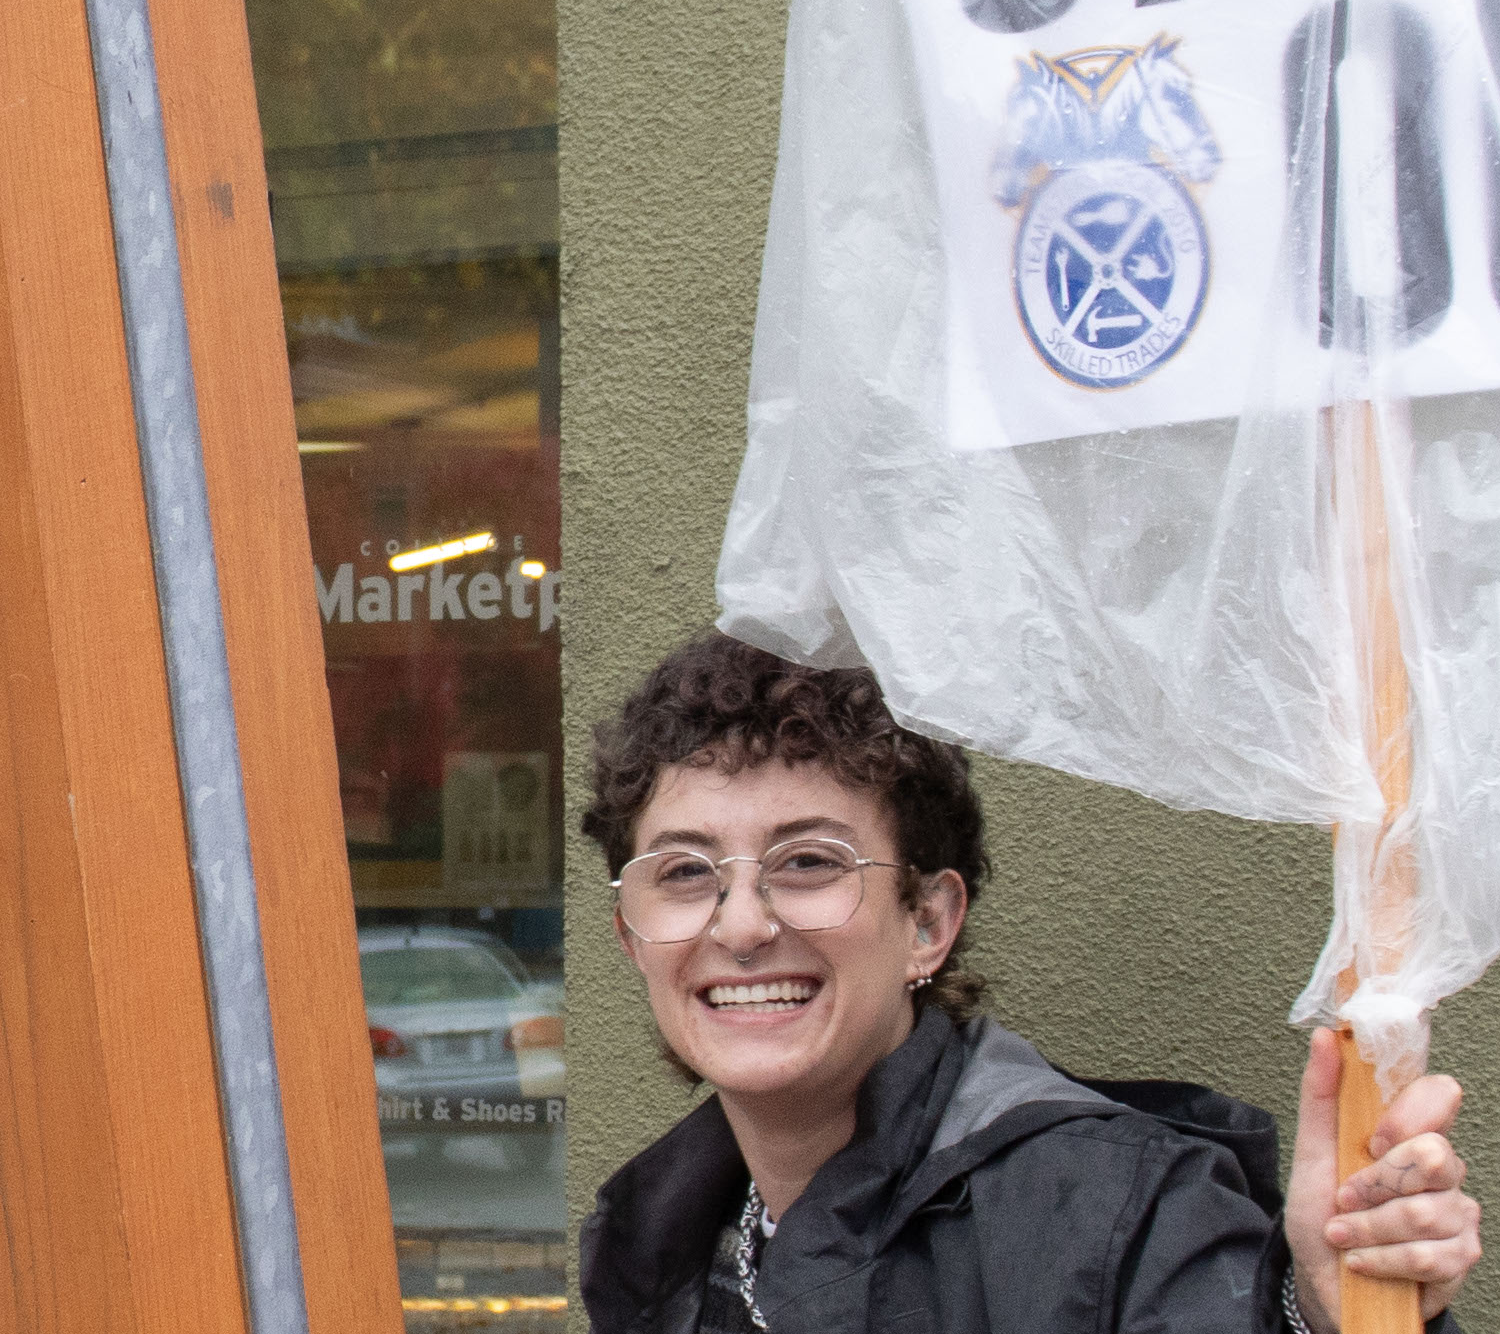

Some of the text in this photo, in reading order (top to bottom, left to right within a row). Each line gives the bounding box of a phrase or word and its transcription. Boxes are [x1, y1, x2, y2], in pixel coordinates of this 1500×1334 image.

[1046, 314, 1181, 376] SKILLED TRADES
[432, 1097, 450, 1121] &
[460, 1097, 536, 1123] Shoes
